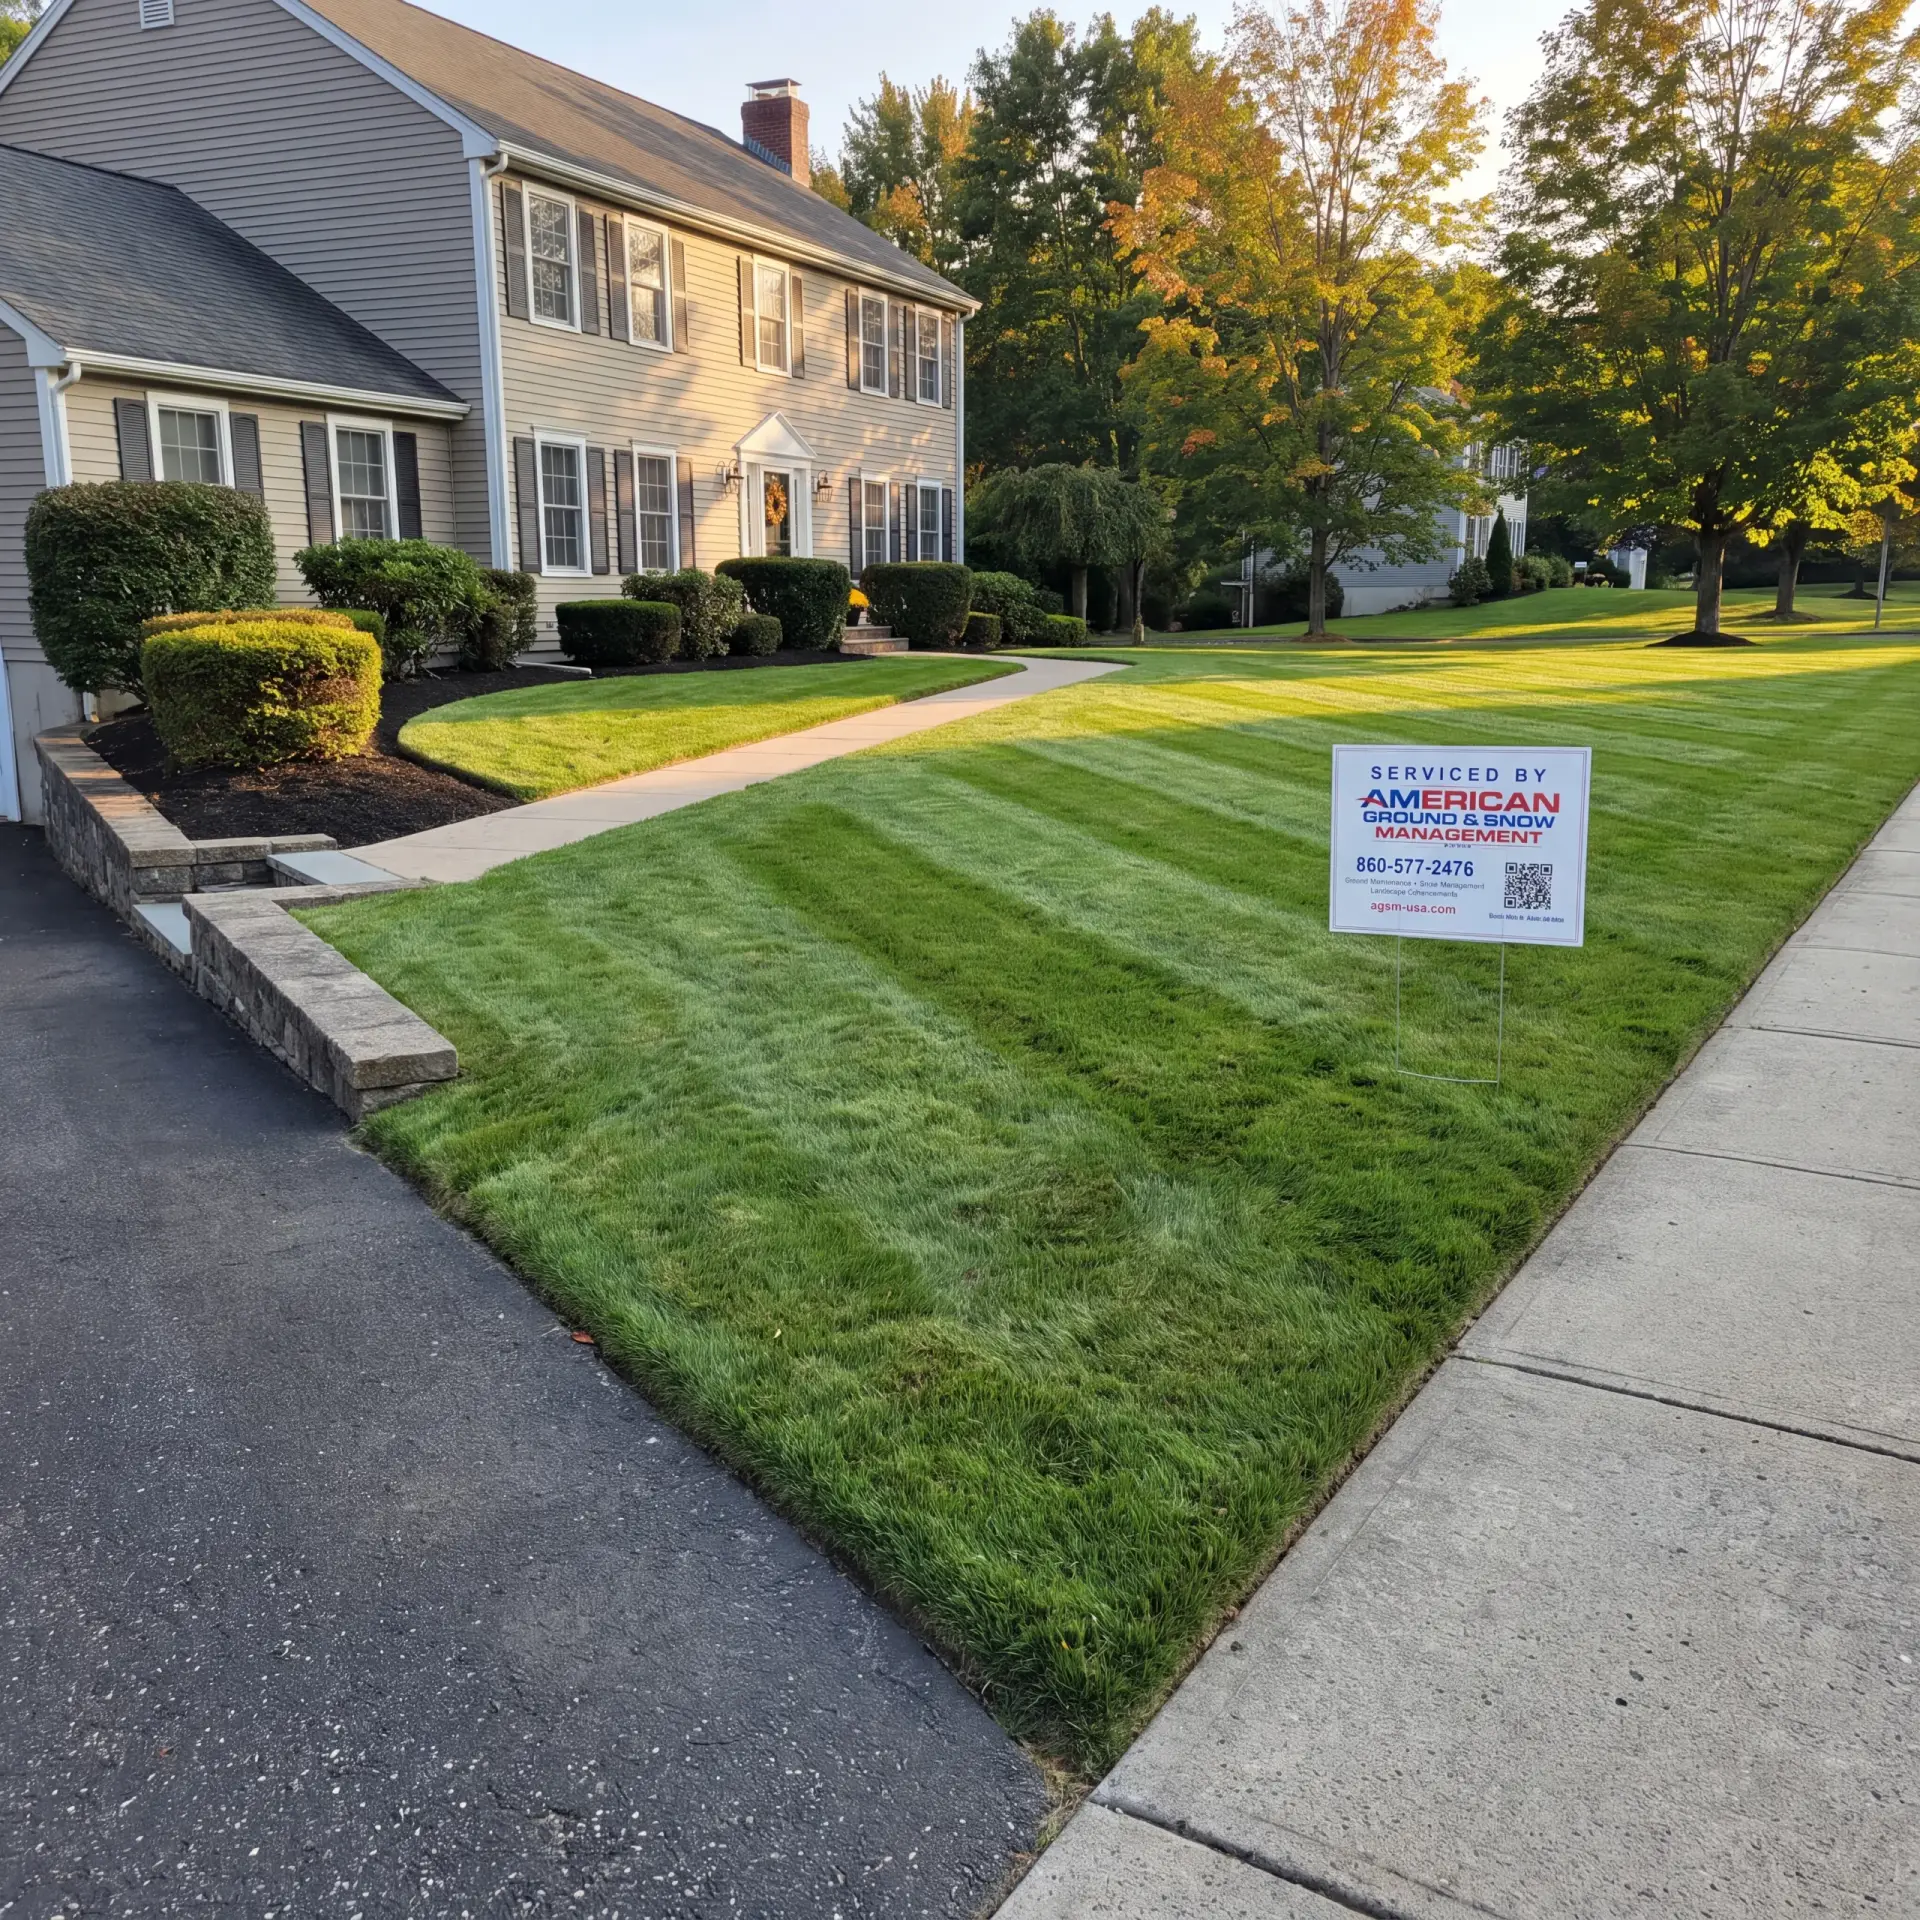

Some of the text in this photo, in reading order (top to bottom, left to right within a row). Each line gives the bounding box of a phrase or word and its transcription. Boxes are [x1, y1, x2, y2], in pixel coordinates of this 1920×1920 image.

[1370, 766, 1547, 783] SERVICED BY
[1356, 789, 1560, 813] AMERICAN
[1363, 811, 1555, 828] GROUND & SNOW
[1375, 826, 1543, 844] MANAGEMENT
[1356, 857, 1474, 877] 860-577-2476
[1370, 902, 1456, 915] agsm-usa.com
